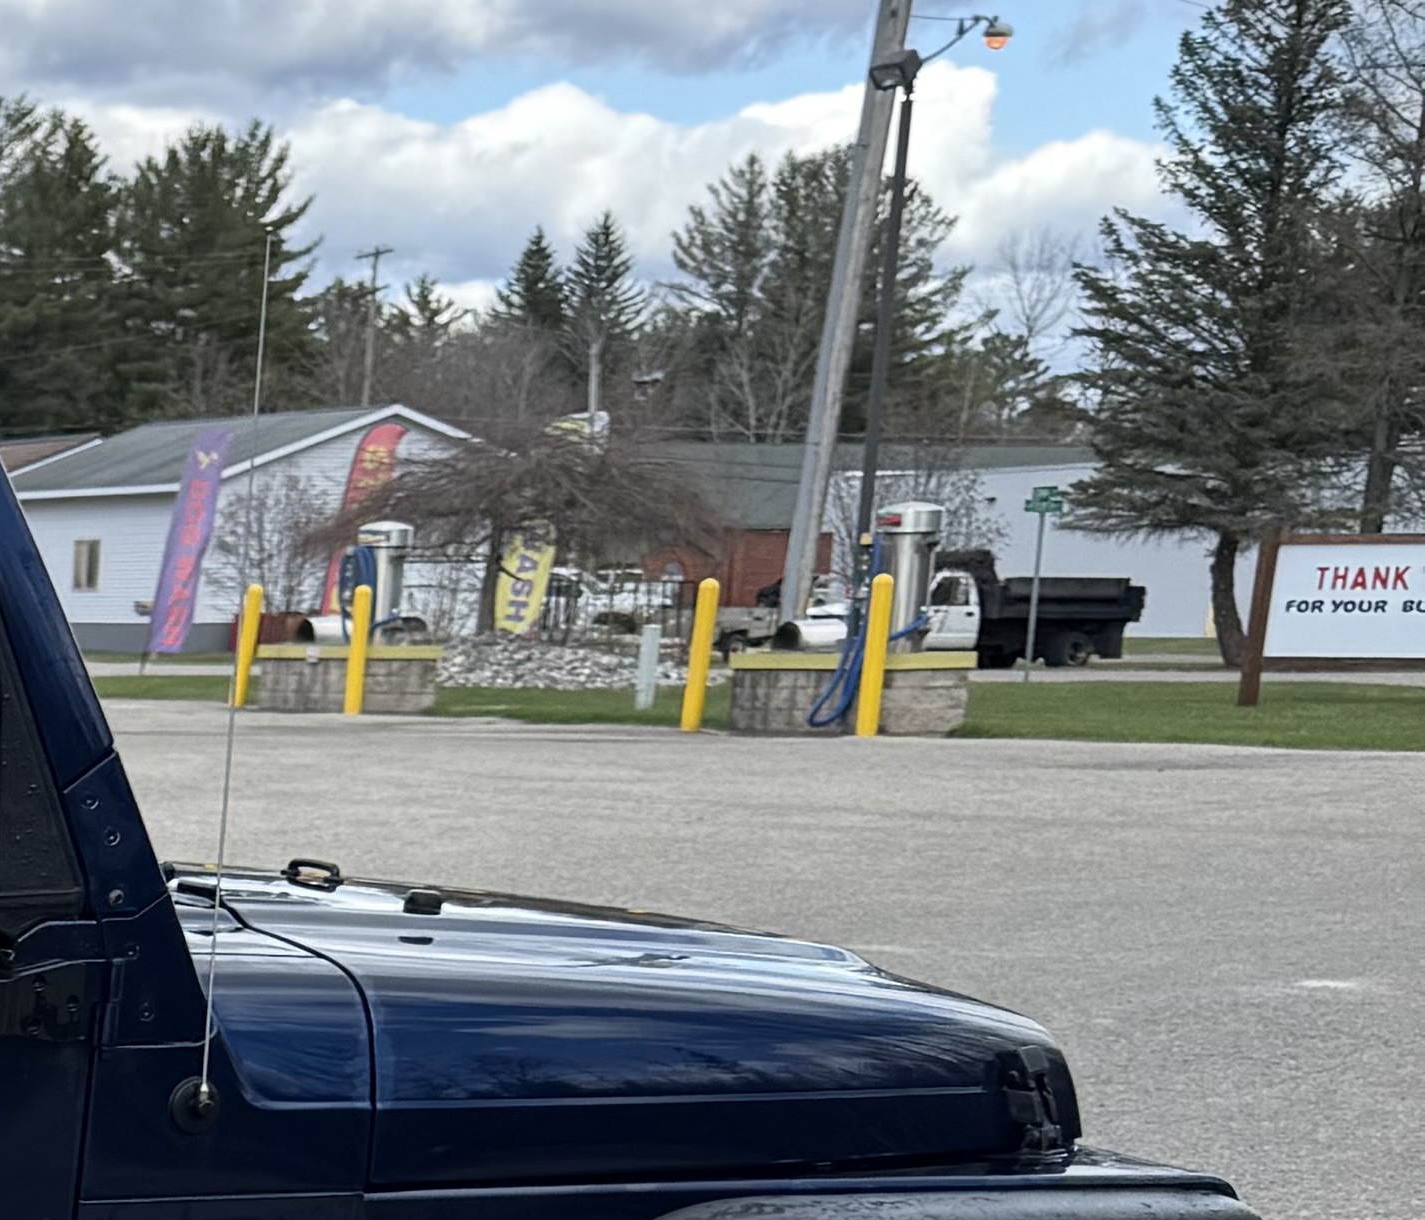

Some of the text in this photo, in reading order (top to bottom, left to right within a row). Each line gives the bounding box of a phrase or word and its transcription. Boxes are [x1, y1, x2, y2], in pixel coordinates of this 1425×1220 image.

[159, 479, 211, 647] DOG WASH
[1316, 566, 1411, 590] THANK
[1285, 599, 1325, 613] FOR
[1331, 599, 1389, 613] YOUR
